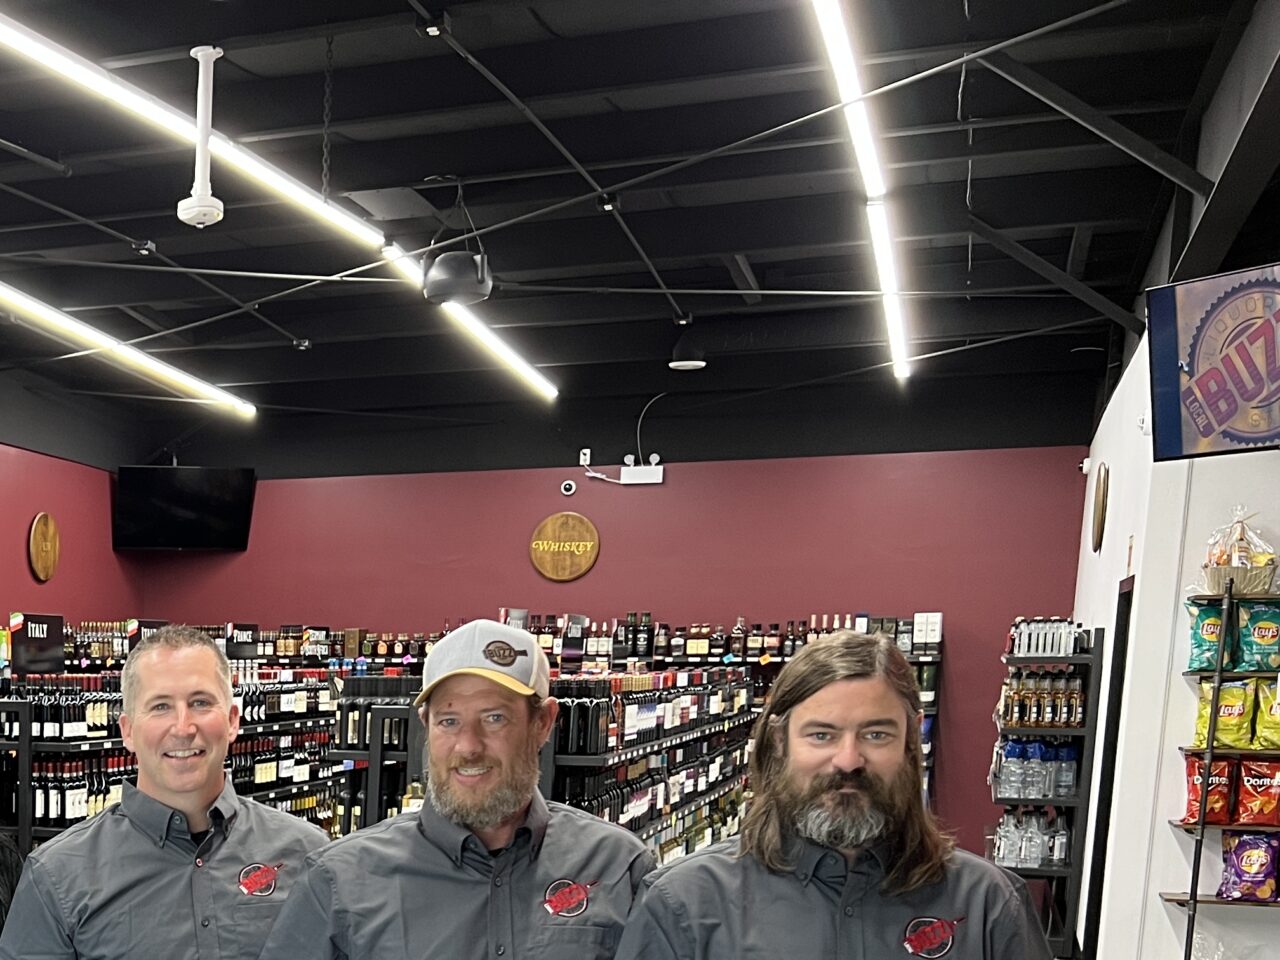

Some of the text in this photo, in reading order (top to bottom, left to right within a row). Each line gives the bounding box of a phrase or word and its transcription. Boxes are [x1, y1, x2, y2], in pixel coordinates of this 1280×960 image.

[1195, 308, 1280, 428] BUZ
[1186, 394, 1209, 432] LOCAL
[531, 540, 594, 555] WHISKEY
[27, 621, 48, 638] ITALY
[1202, 623, 1221, 636] Lay
[487, 648, 515, 660] BUZZ
[1193, 775, 1229, 785] Dritos
